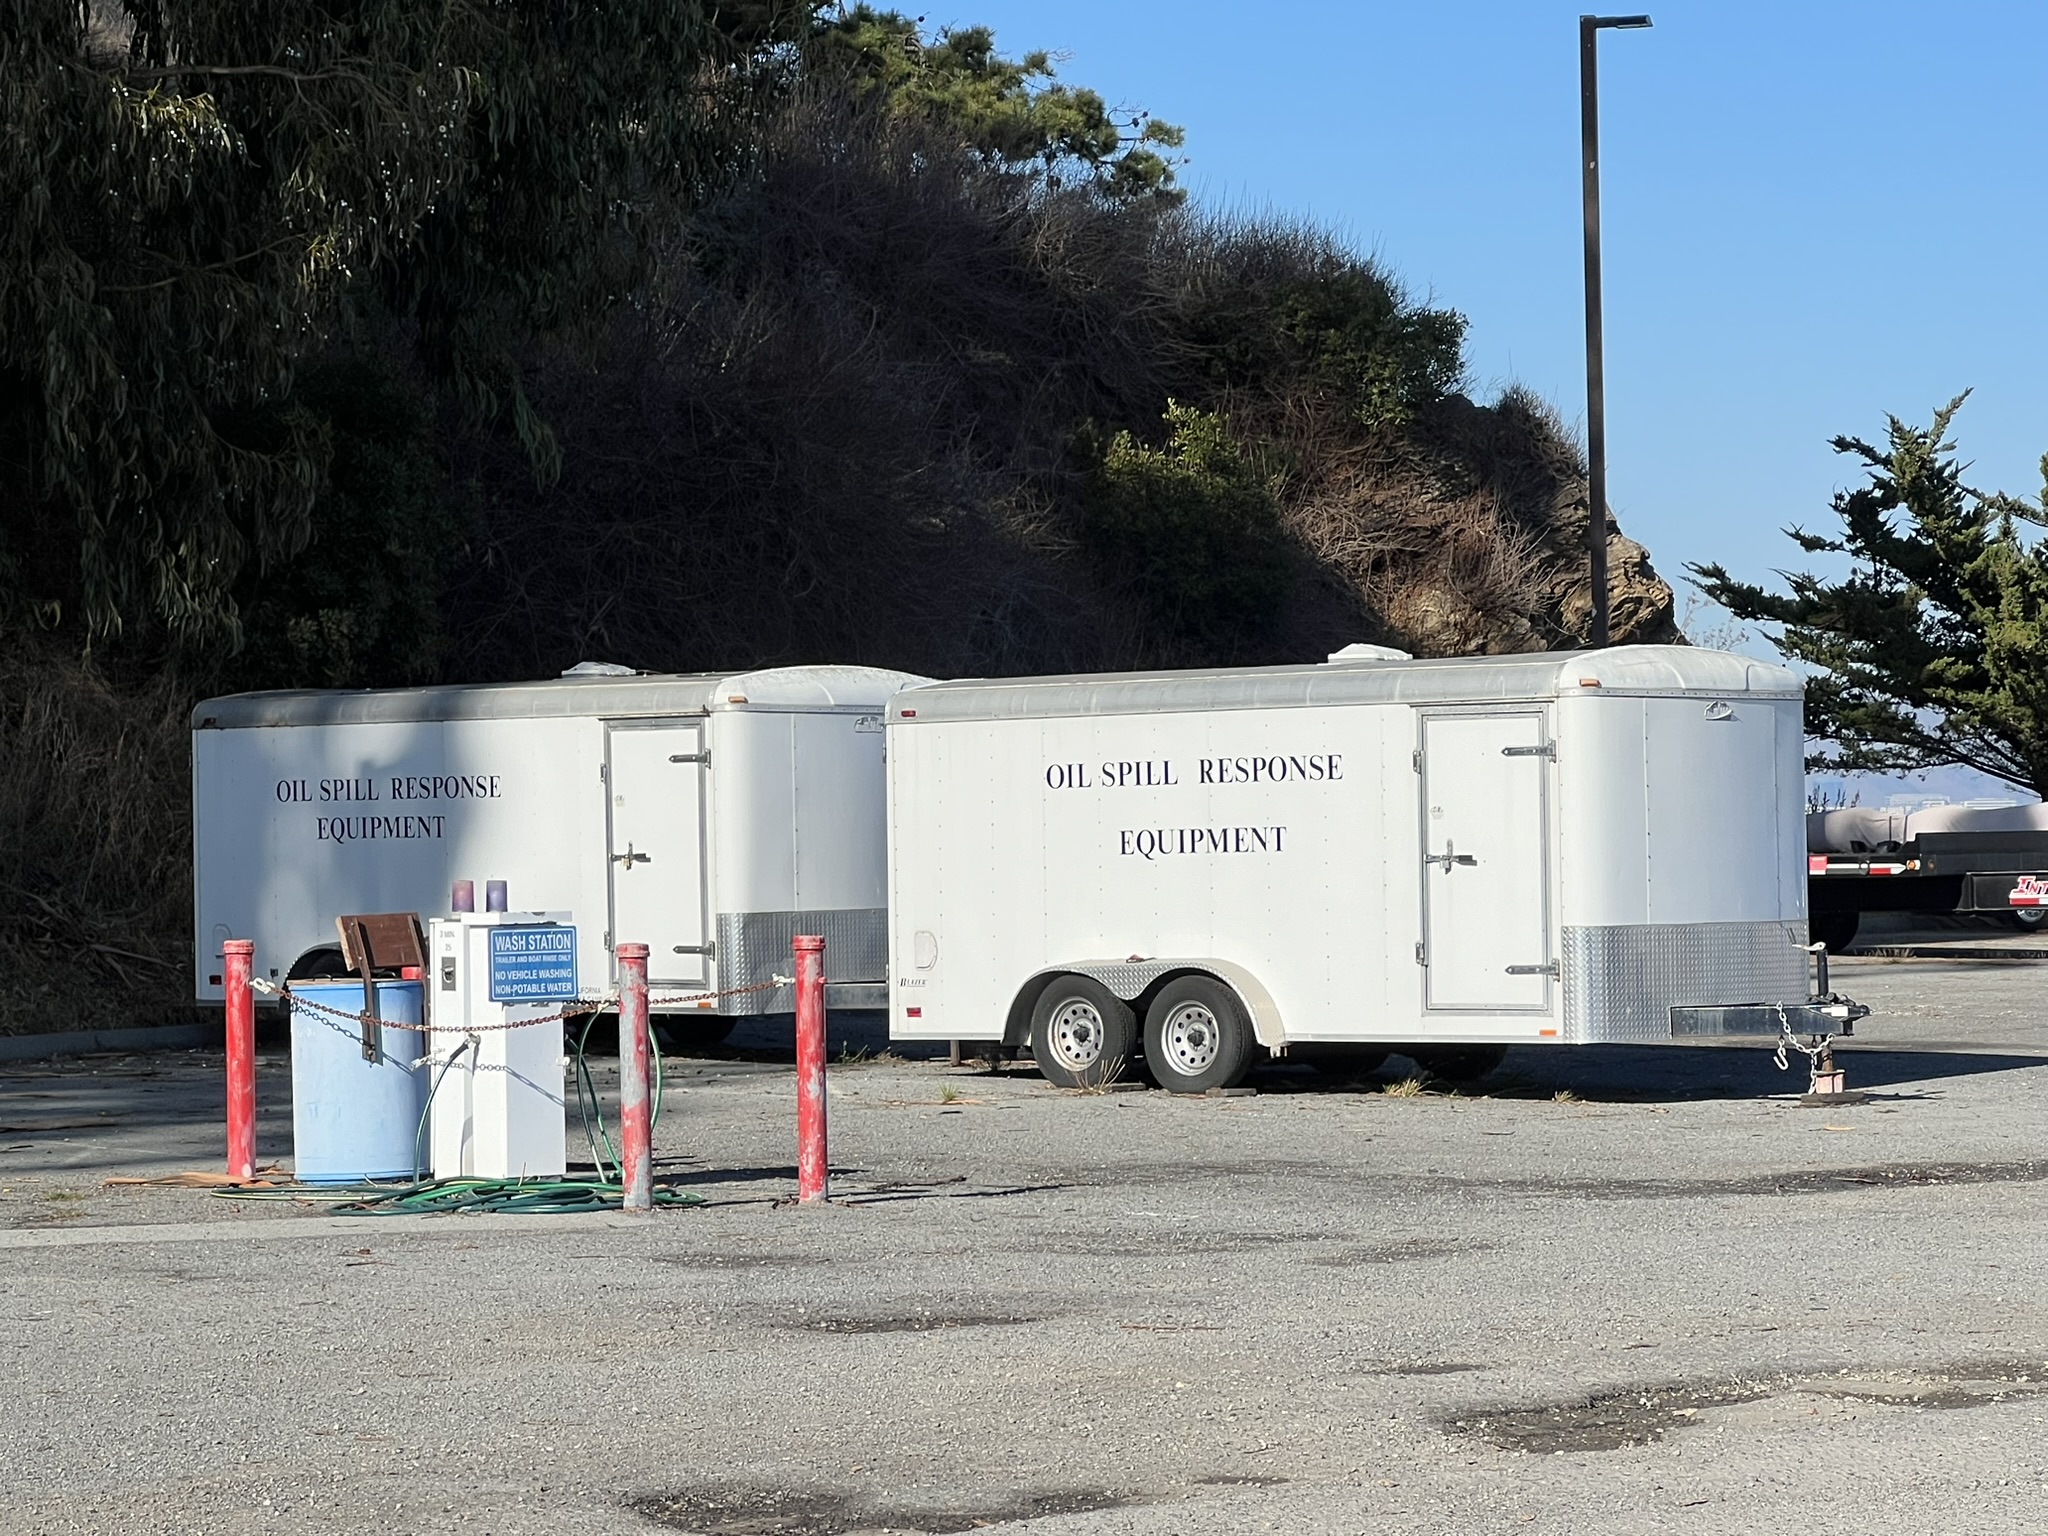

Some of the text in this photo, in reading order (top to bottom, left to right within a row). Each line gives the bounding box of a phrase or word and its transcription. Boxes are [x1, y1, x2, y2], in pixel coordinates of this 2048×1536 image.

[1046, 754, 1344, 789] OIL SPILL RESPONSE
[276, 775, 502, 802] OIL SPILL RESPONSE
[316, 816, 445, 844] EQUIPMENT
[1119, 826, 1287, 860] EQUIPMENT
[495, 934, 571, 951] WASH STATION
[516, 955, 528, 963] AND
[558, 954, 571, 962] ONLY
[495, 968, 572, 980] NO VEHICLE WASHING
[495, 982, 573, 994] NON-POTABLE WATER
